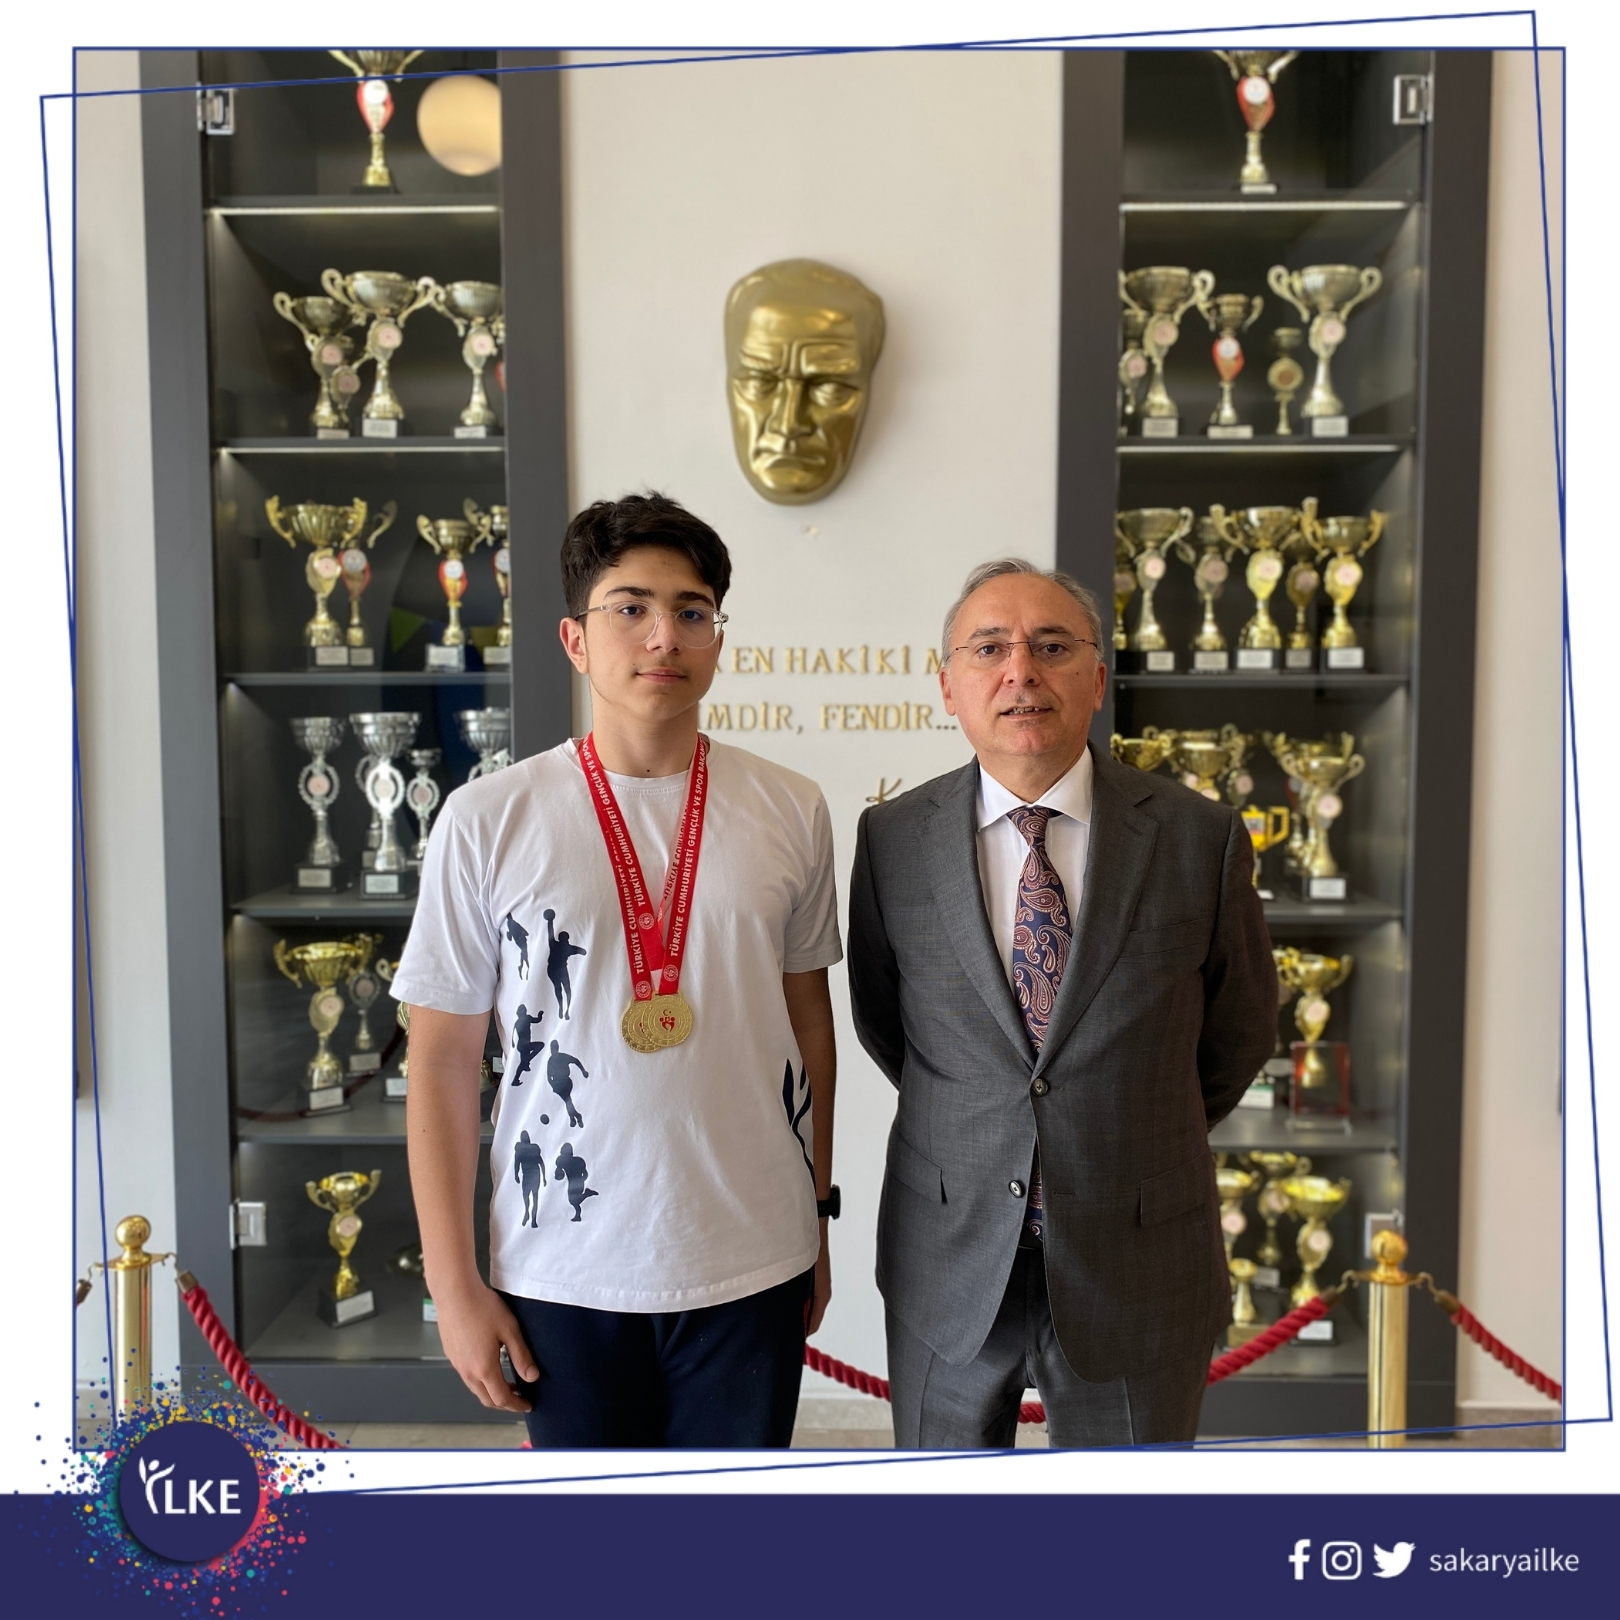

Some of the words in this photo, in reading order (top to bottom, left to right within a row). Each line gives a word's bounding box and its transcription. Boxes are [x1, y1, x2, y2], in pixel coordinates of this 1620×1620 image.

[732, 646, 774, 674] EN
[786, 644, 912, 675] HAKİKİ
[587, 760, 597, 771] VE
[694, 773, 704, 795] SPOR
[590, 770, 611, 805] GENÇLİK
[693, 795, 702, 806] VE
[604, 806, 634, 865] CUMHURİYETİ
[687, 808, 700, 847] GENÇLİK
[628, 867, 646, 907] TÜRKİYE
[677, 848, 695, 914] CUMHURİYETİ
[630, 932, 645, 975] TÜRKİYE
[669, 915, 684, 957] TÜRKİYE
